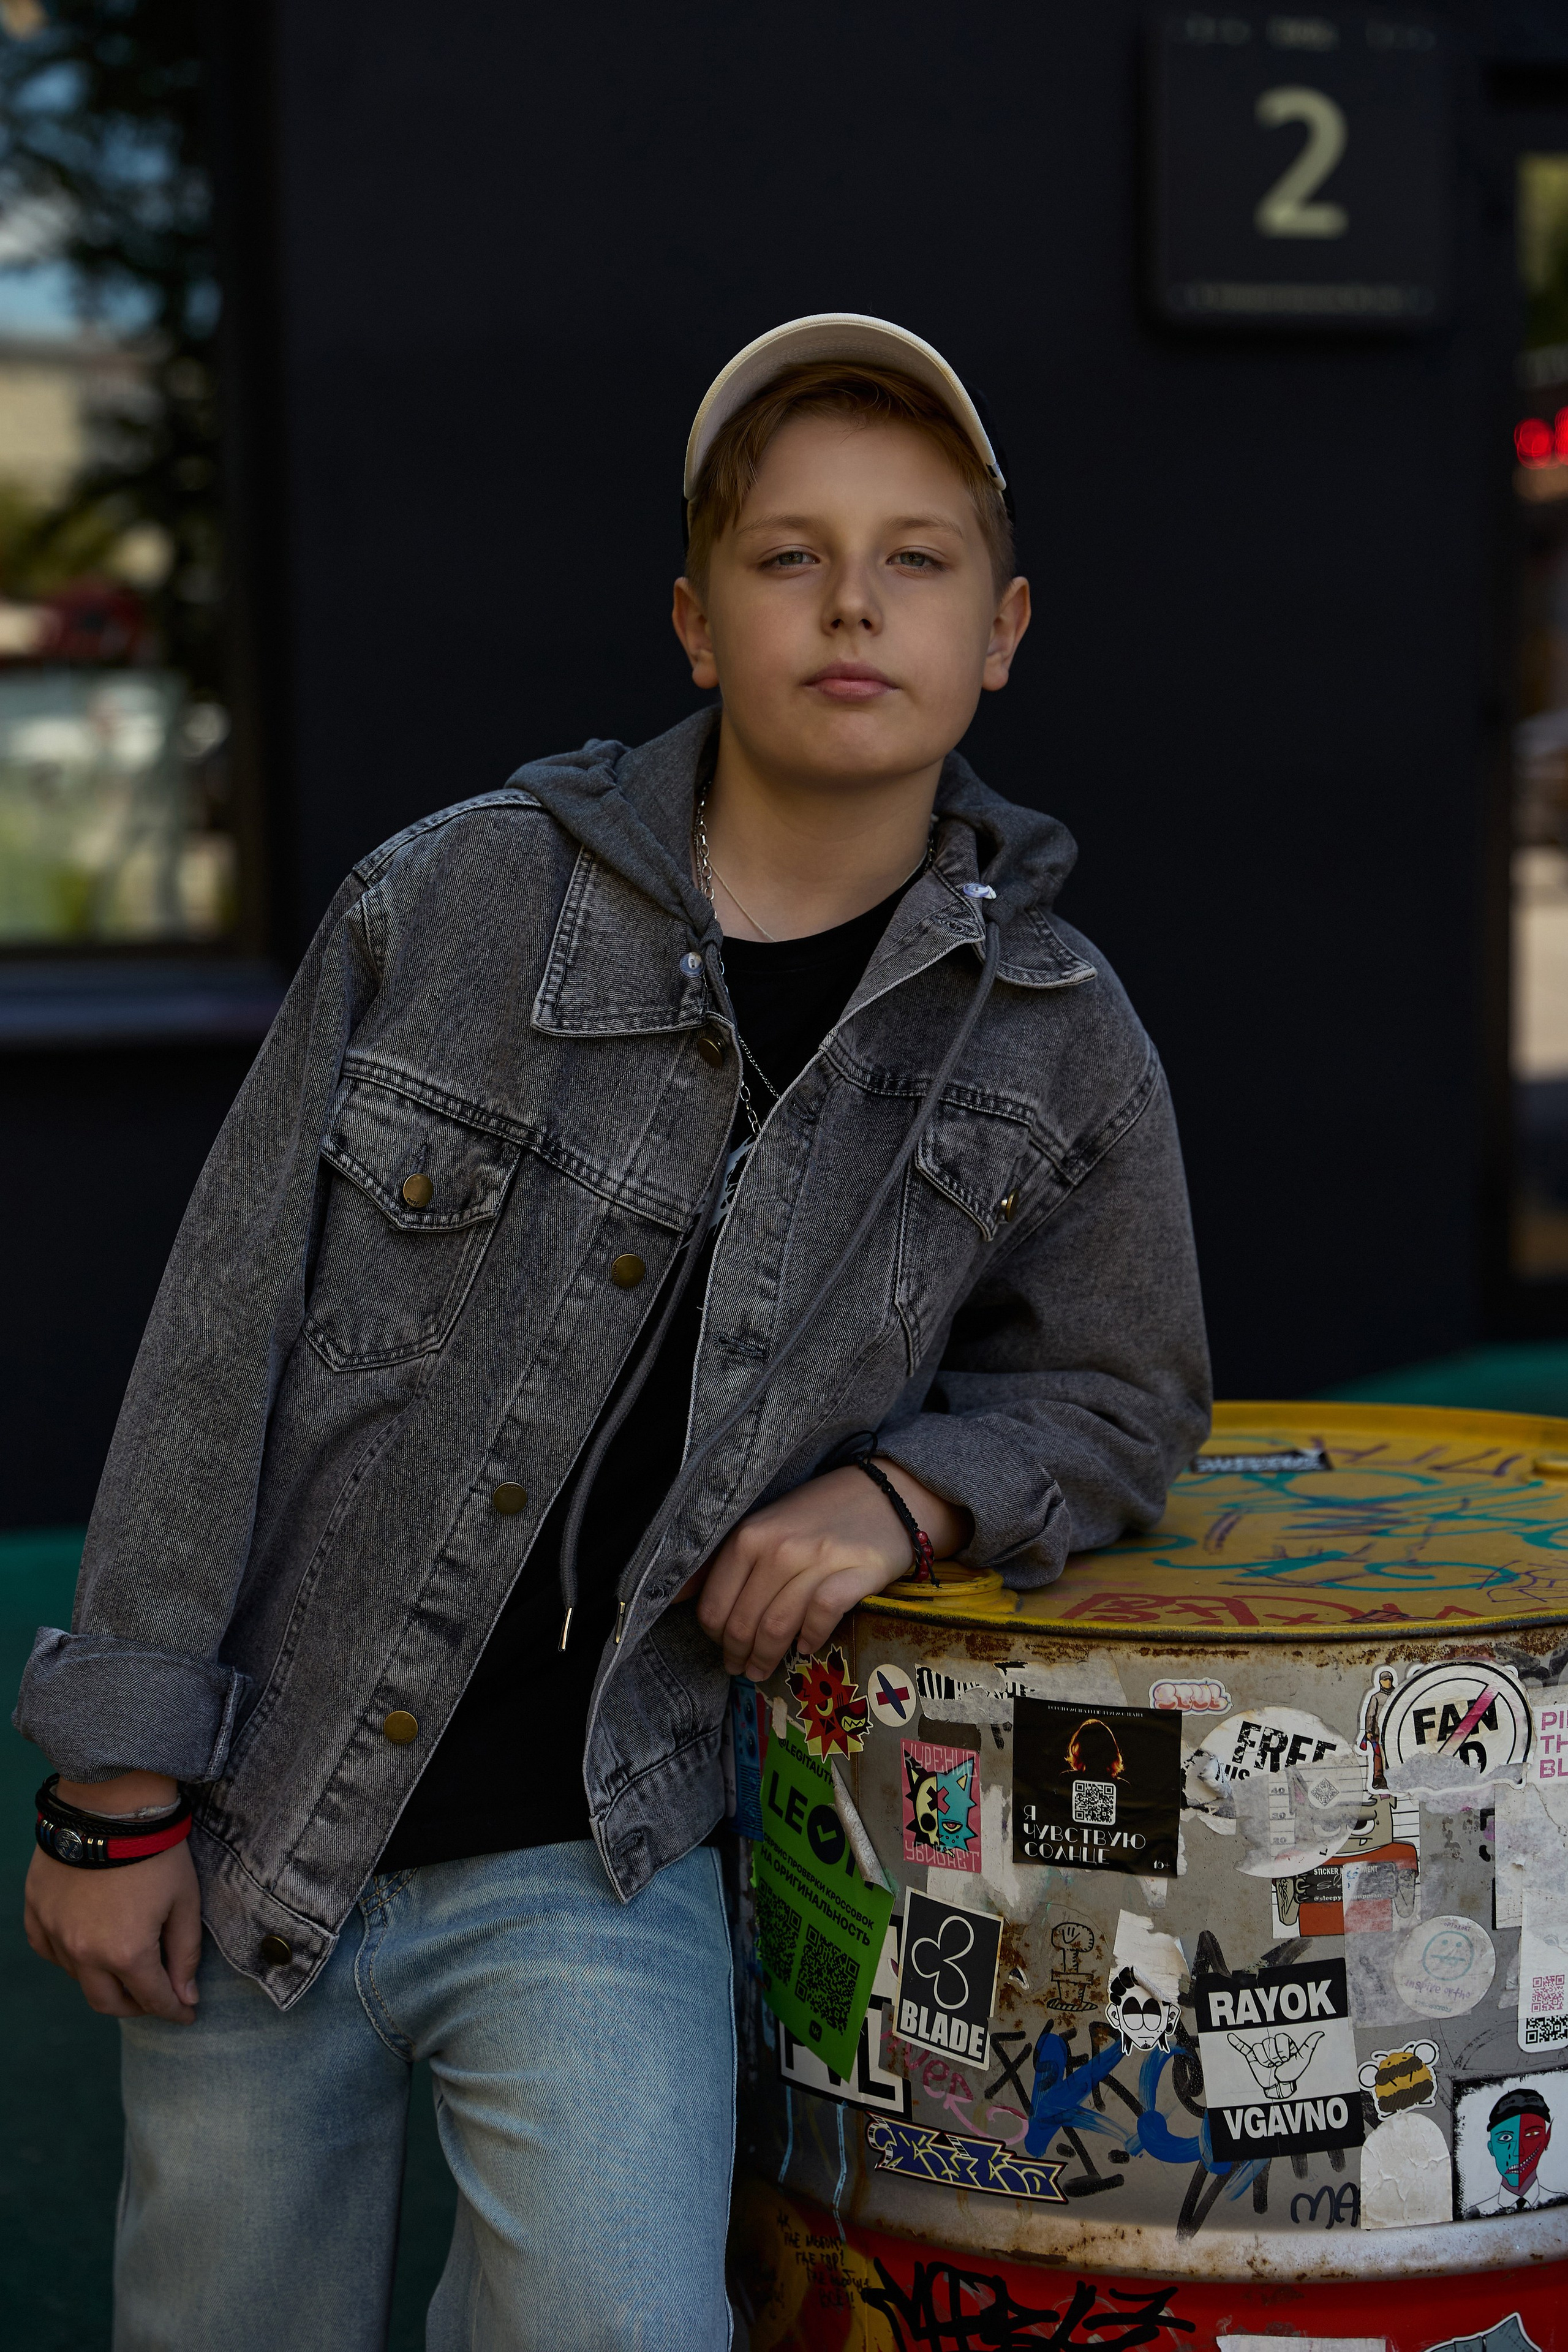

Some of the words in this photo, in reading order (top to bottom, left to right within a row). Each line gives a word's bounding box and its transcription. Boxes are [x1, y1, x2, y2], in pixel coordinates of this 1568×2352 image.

[1254, 85, 1348, 239] 2
[1413, 1699, 1498, 1745] FAN
[1542, 1710, 1568, 1730] PI
[902, 1741, 978, 1777] КУРЕНИЕ
[1023, 1804, 1036, 1821] Я
[1023, 1823, 1146, 1850] ЧУВСТВУЮ
[1024, 1841, 1110, 1865] СОЛНЦЕ
[761, 1845, 772, 1866] НА
[774, 1860, 870, 1946] ОРИГИНАЛЬНОСТЬ
[764, 1832, 787, 1860] СЕРВИС
[788, 1855, 825, 1894] ПРОВЕРКИ
[826, 1887, 875, 1930] КРОССОВОК
[1208, 1980, 1336, 2027] RAYOK
[900, 1999, 985, 2059] BLADE
[1223, 2097, 1348, 2140] VGAVNO
[1291, 2182, 1361, 2230] MA
